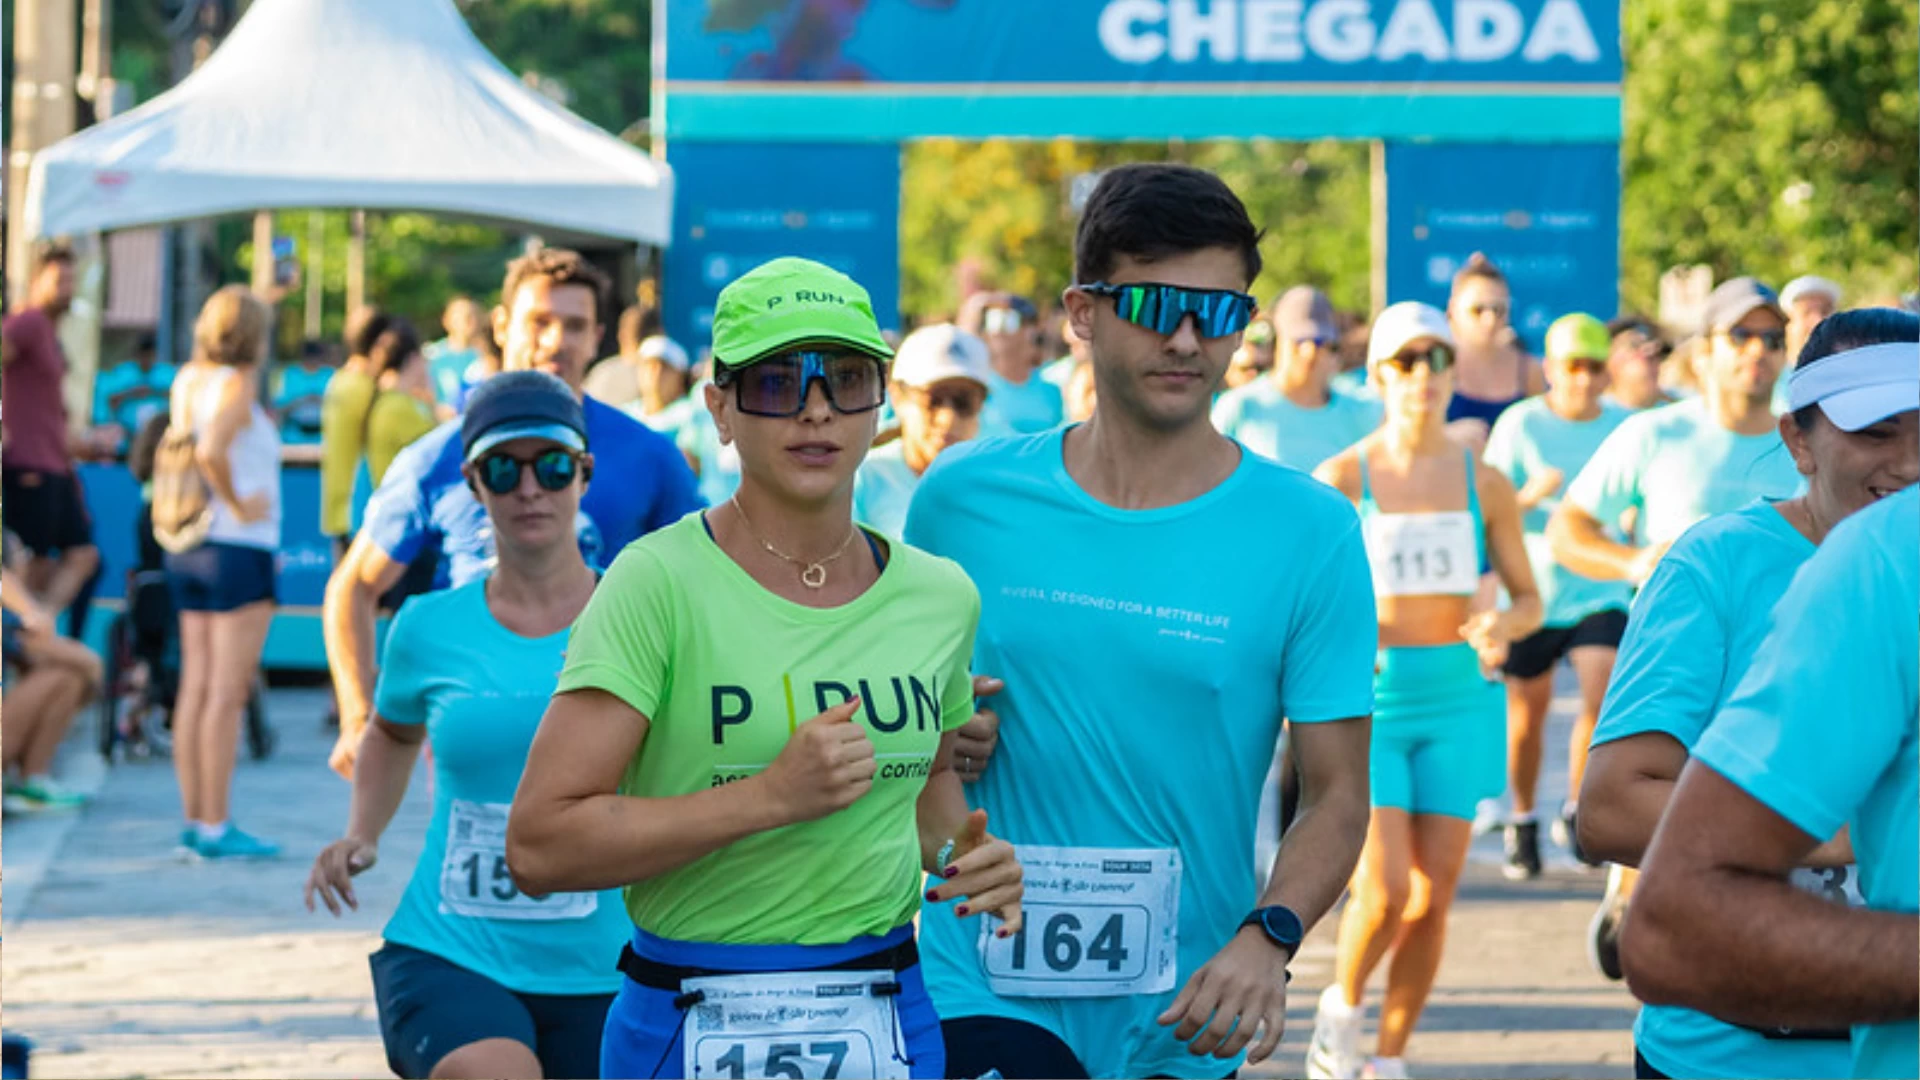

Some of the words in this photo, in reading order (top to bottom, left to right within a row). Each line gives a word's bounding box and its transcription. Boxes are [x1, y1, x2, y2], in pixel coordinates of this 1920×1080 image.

[1098, 0, 1600, 63] CHEGADA
[767, 296, 782, 309] P
[795, 289, 845, 304] RUN
[1388, 547, 1452, 579] 113
[1051, 590, 1116, 610] DESIGNED
[1117, 600, 1143, 614] FOR
[1155, 606, 1203, 624] BETTER
[1205, 614, 1230, 630] LIFE
[711, 685, 753, 744] P
[881, 757, 932, 779] corrid
[461, 853, 549, 901] 15
[1011, 911, 1128, 973] 164
[715, 1041, 850, 1079] 157
